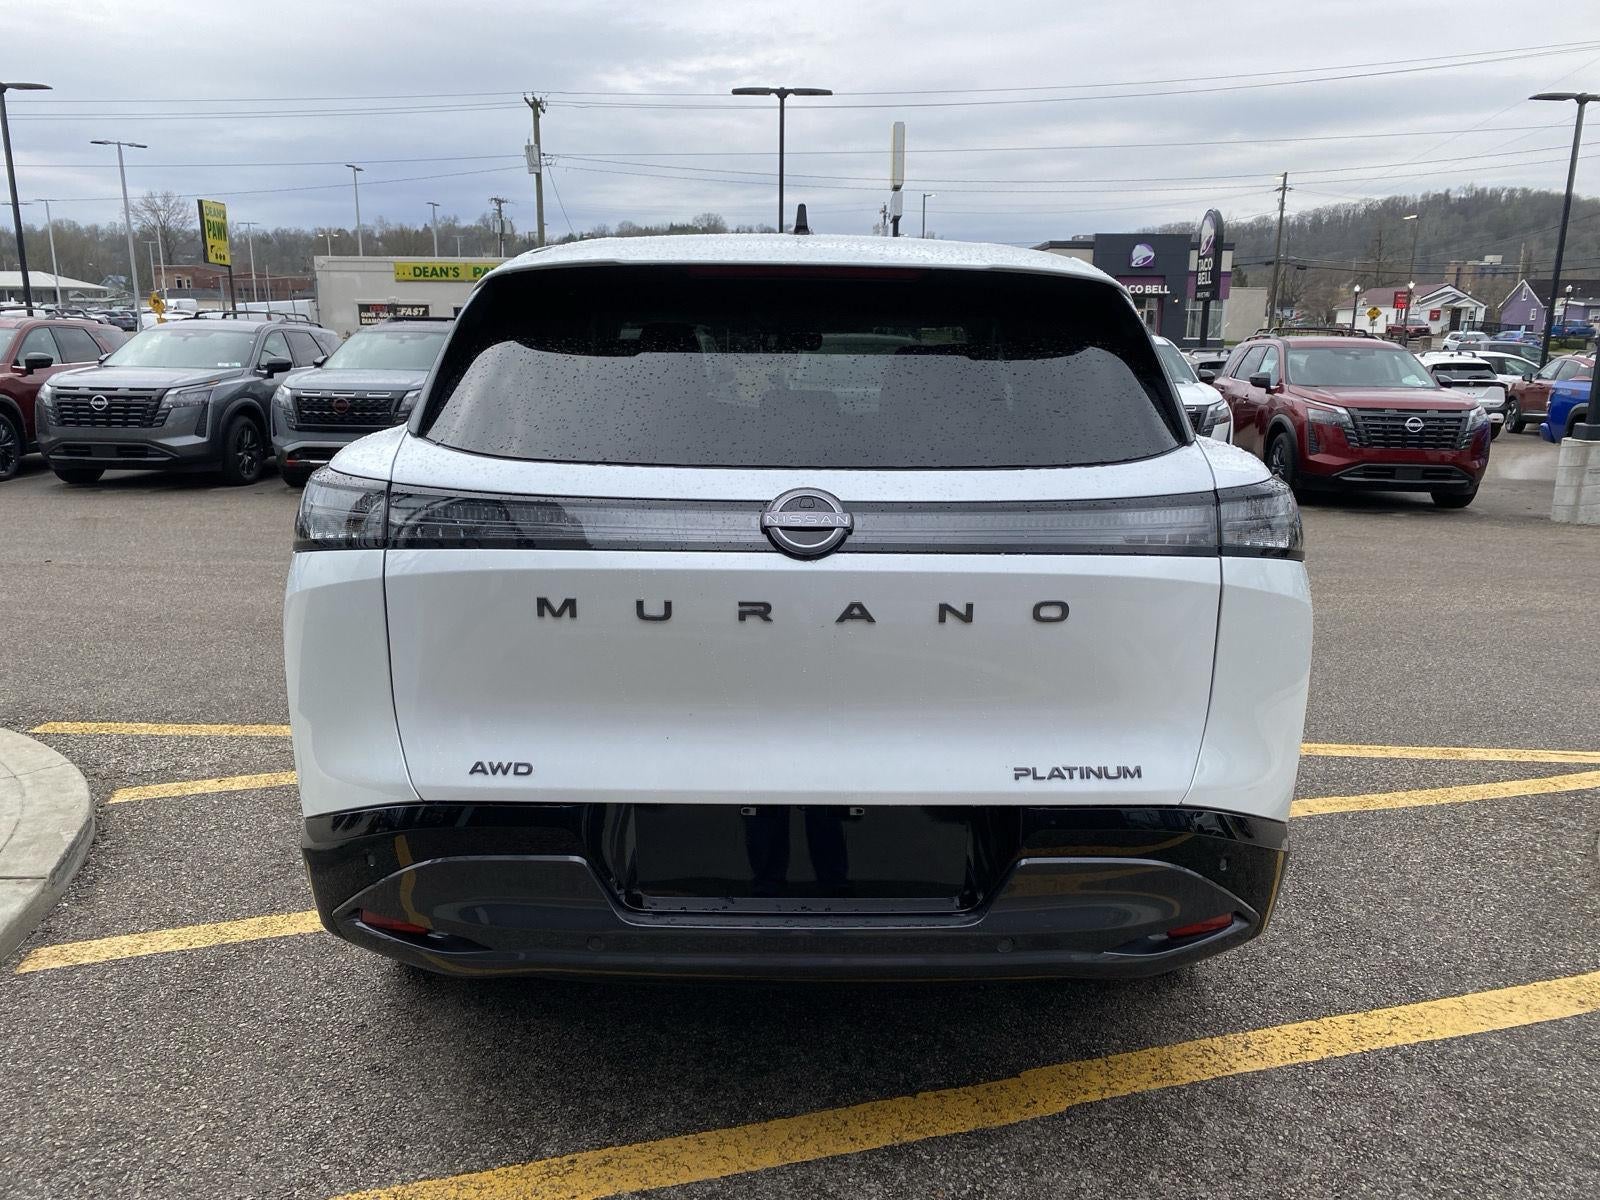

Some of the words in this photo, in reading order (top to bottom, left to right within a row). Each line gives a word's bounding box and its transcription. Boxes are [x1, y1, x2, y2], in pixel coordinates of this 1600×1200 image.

[206, 219, 227, 242] PAWN
[1198, 257, 1213, 271] TACO
[1197, 272, 1212, 285] BELL
[1145, 284, 1170, 294] BELL
[400, 307, 426, 316] FAST
[766, 515, 848, 525] NISSAN
[536, 596, 1071, 623] MURANO
[468, 761, 534, 776] AWD
[1013, 765, 1142, 780] PLATINUM
